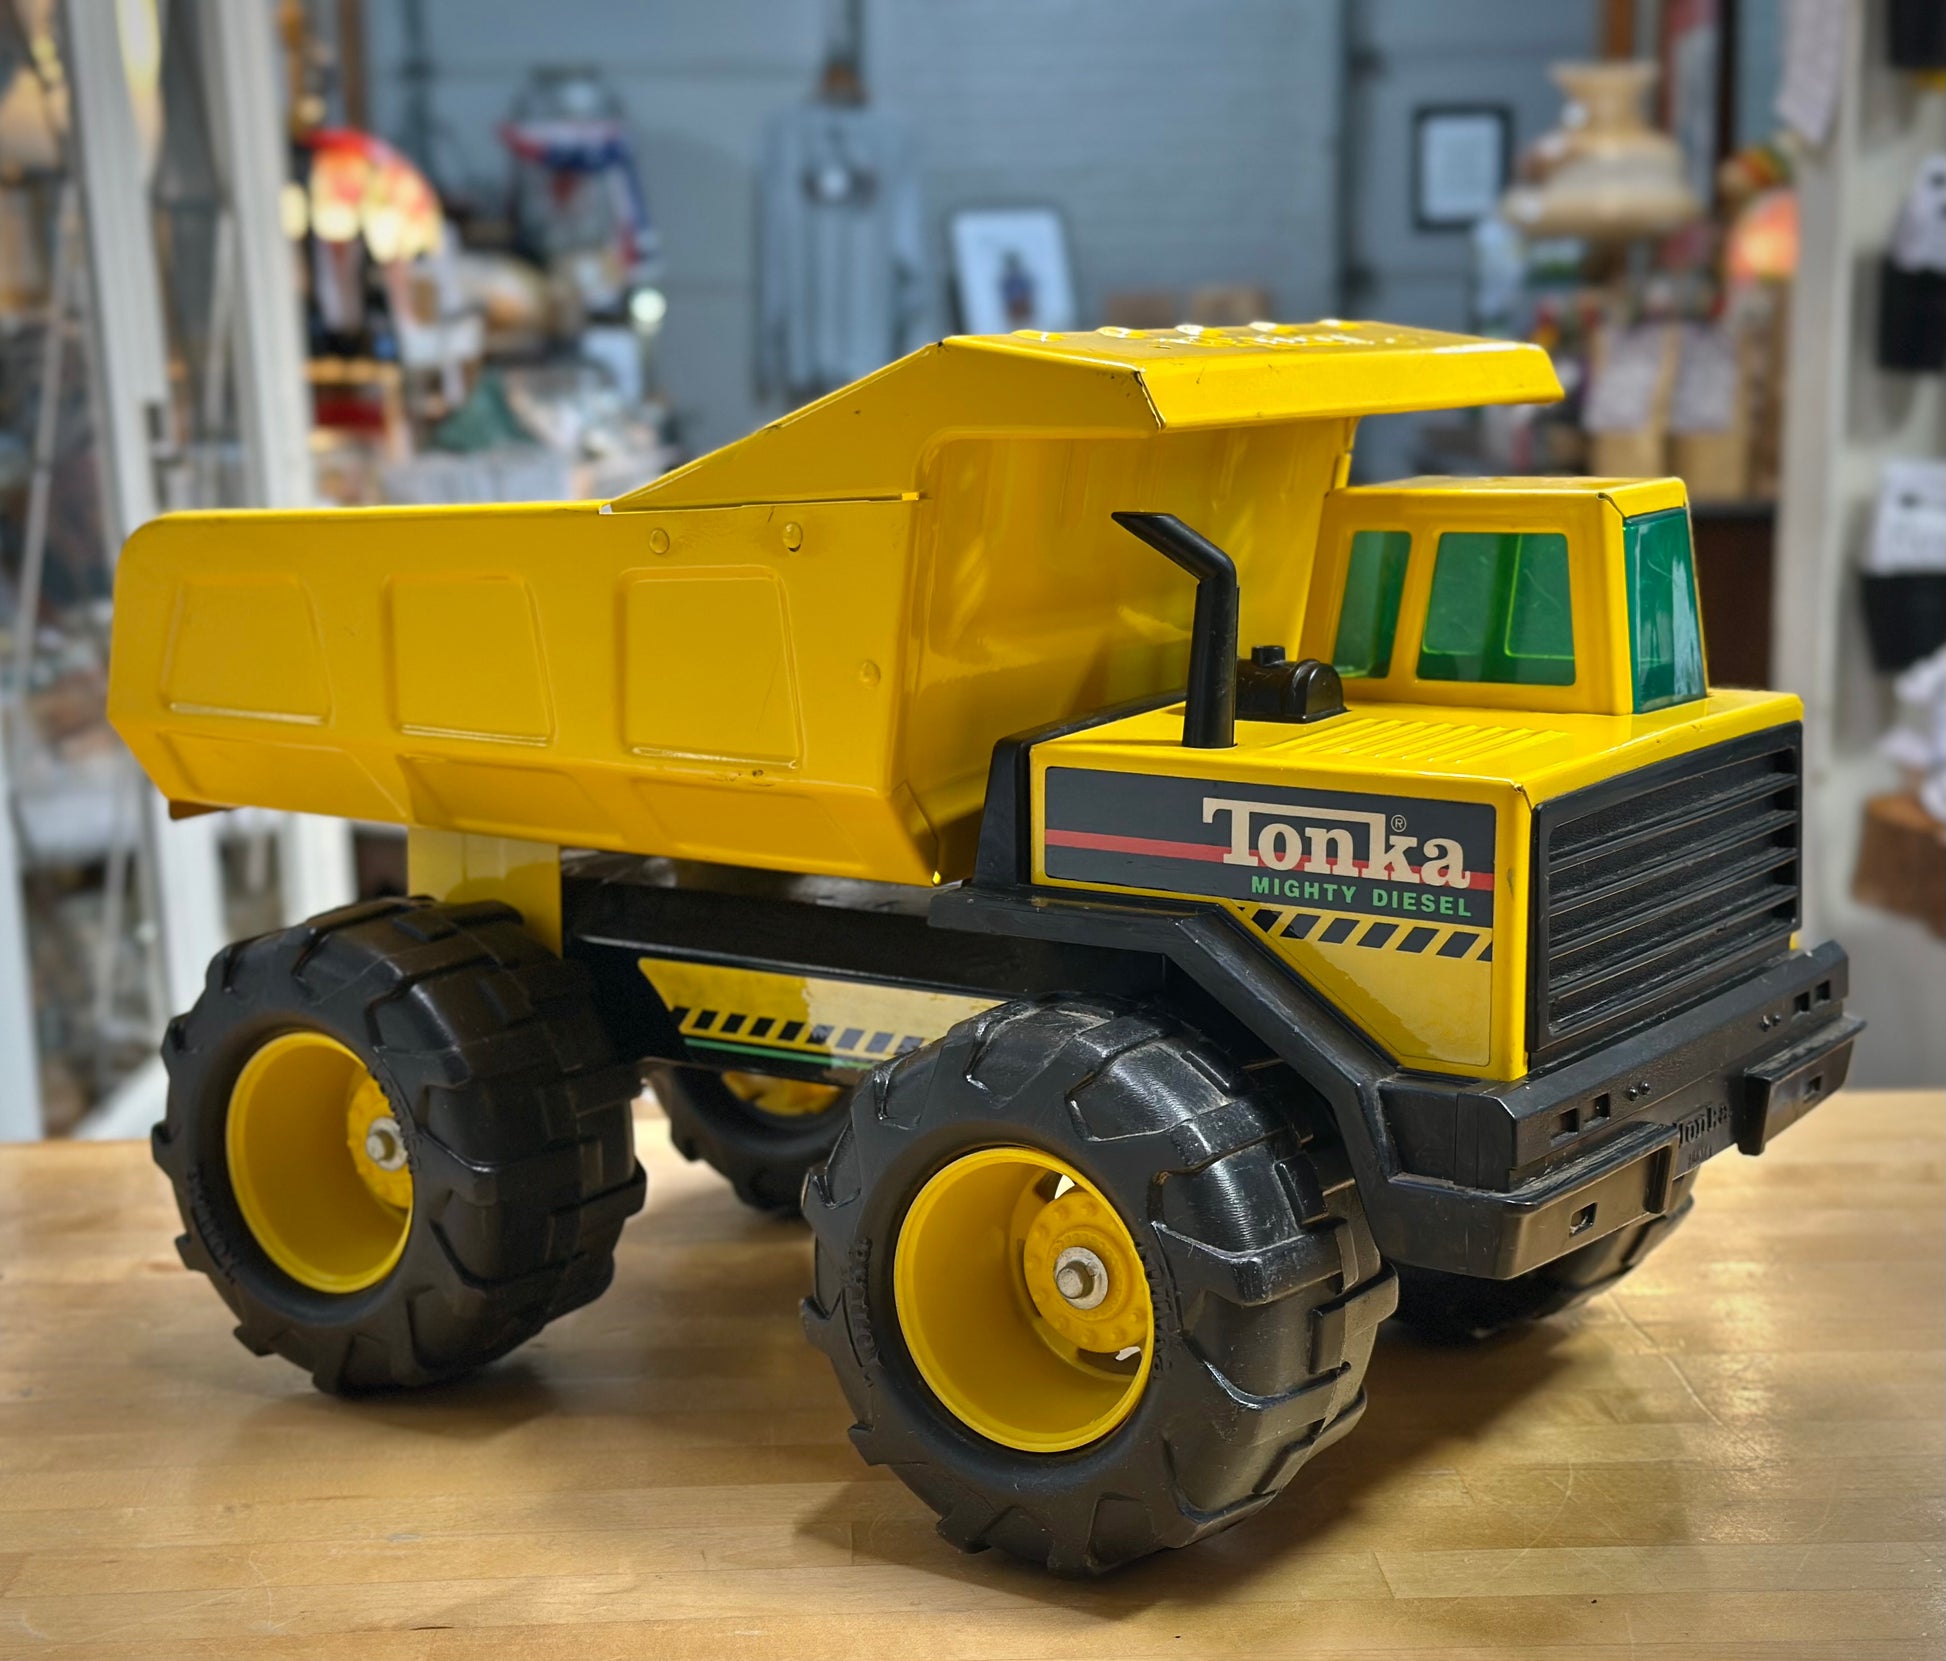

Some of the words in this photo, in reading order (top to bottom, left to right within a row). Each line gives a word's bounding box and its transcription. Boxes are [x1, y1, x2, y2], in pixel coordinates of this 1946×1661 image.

[1202, 797, 1471, 889] Tonka
[1251, 876, 1358, 903] MIGHTY
[1372, 889, 1472, 917] DIESEL
